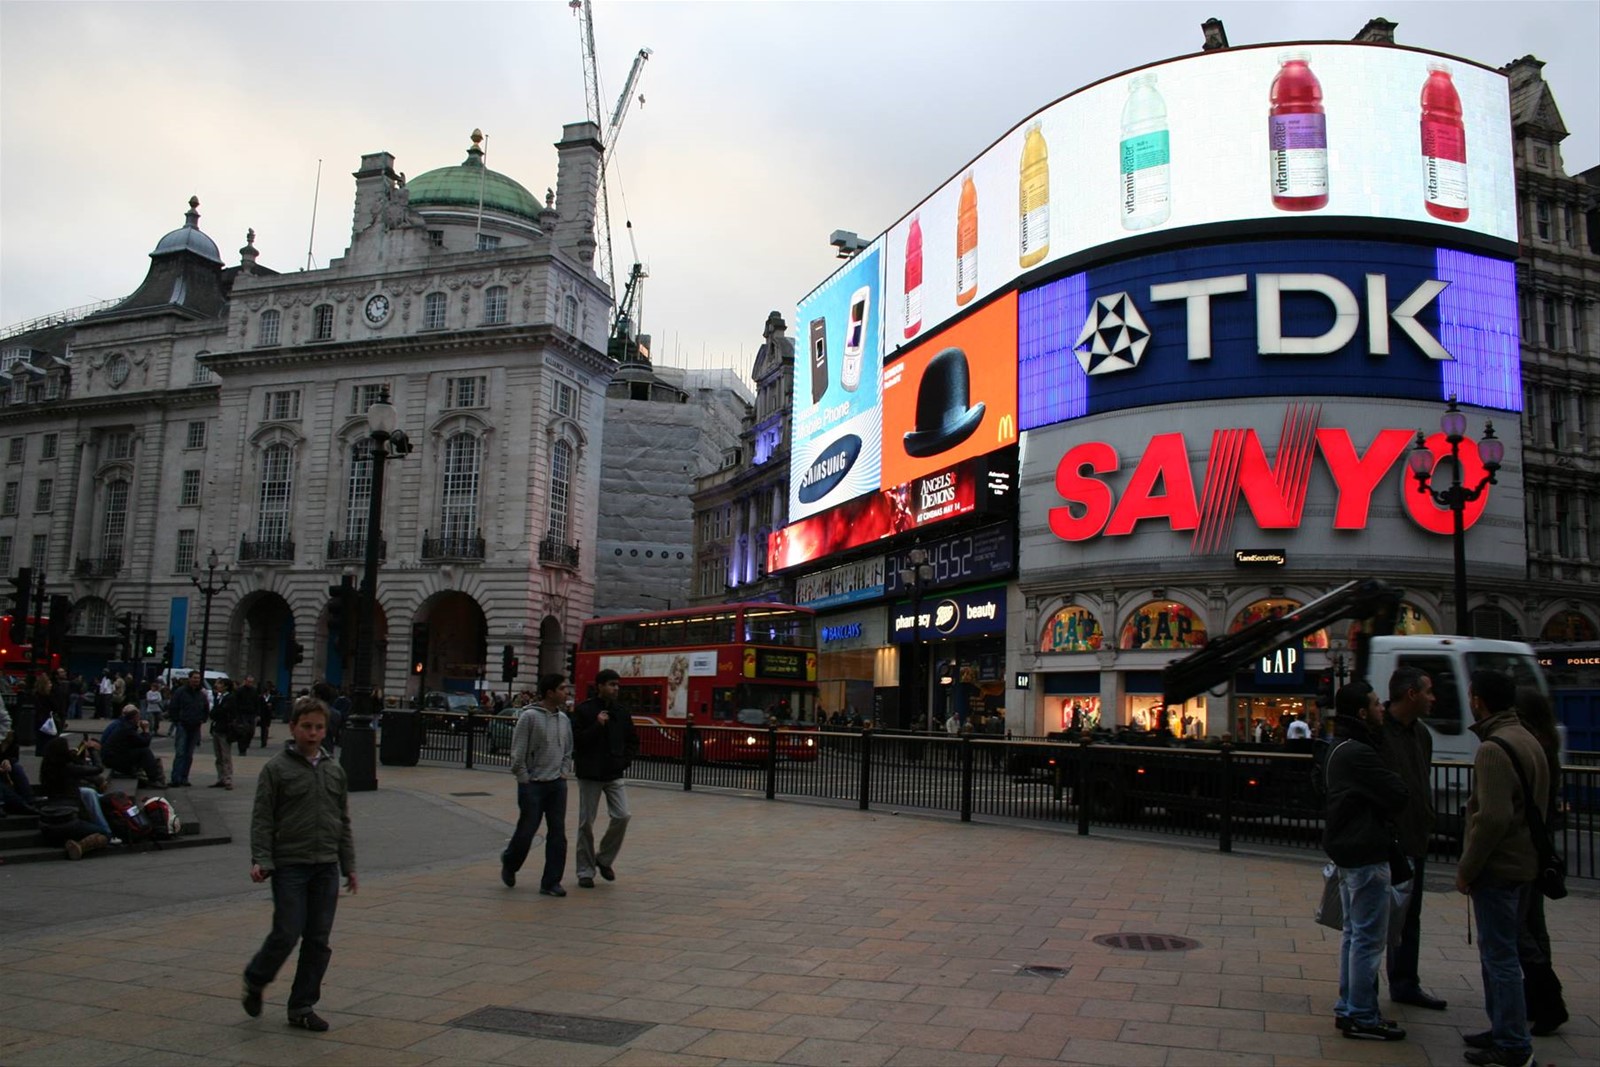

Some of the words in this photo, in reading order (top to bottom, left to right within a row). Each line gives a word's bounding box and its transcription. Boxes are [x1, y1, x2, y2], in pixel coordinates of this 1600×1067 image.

[1274, 121, 1288, 193] vitaminwater
[1124, 145, 1135, 214] vitaminwater
[1150, 271, 1455, 362] TDK
[823, 400, 850, 425] Phone
[802, 451, 846, 488] SAMSUNG
[1047, 404, 1490, 554] SANYO
[920, 472, 951, 496] ANGELS
[921, 487, 955, 510] DEMONS
[954, 502, 961, 511] 14
[966, 601, 996, 620] beauty
[828, 622, 863, 641] BARCLAYS
[1053, 614, 1093, 648] GAP
[1135, 611, 1193, 648] GAP
[1262, 647, 1298, 675] GAP
[1567, 657, 1600, 666] POLICE
